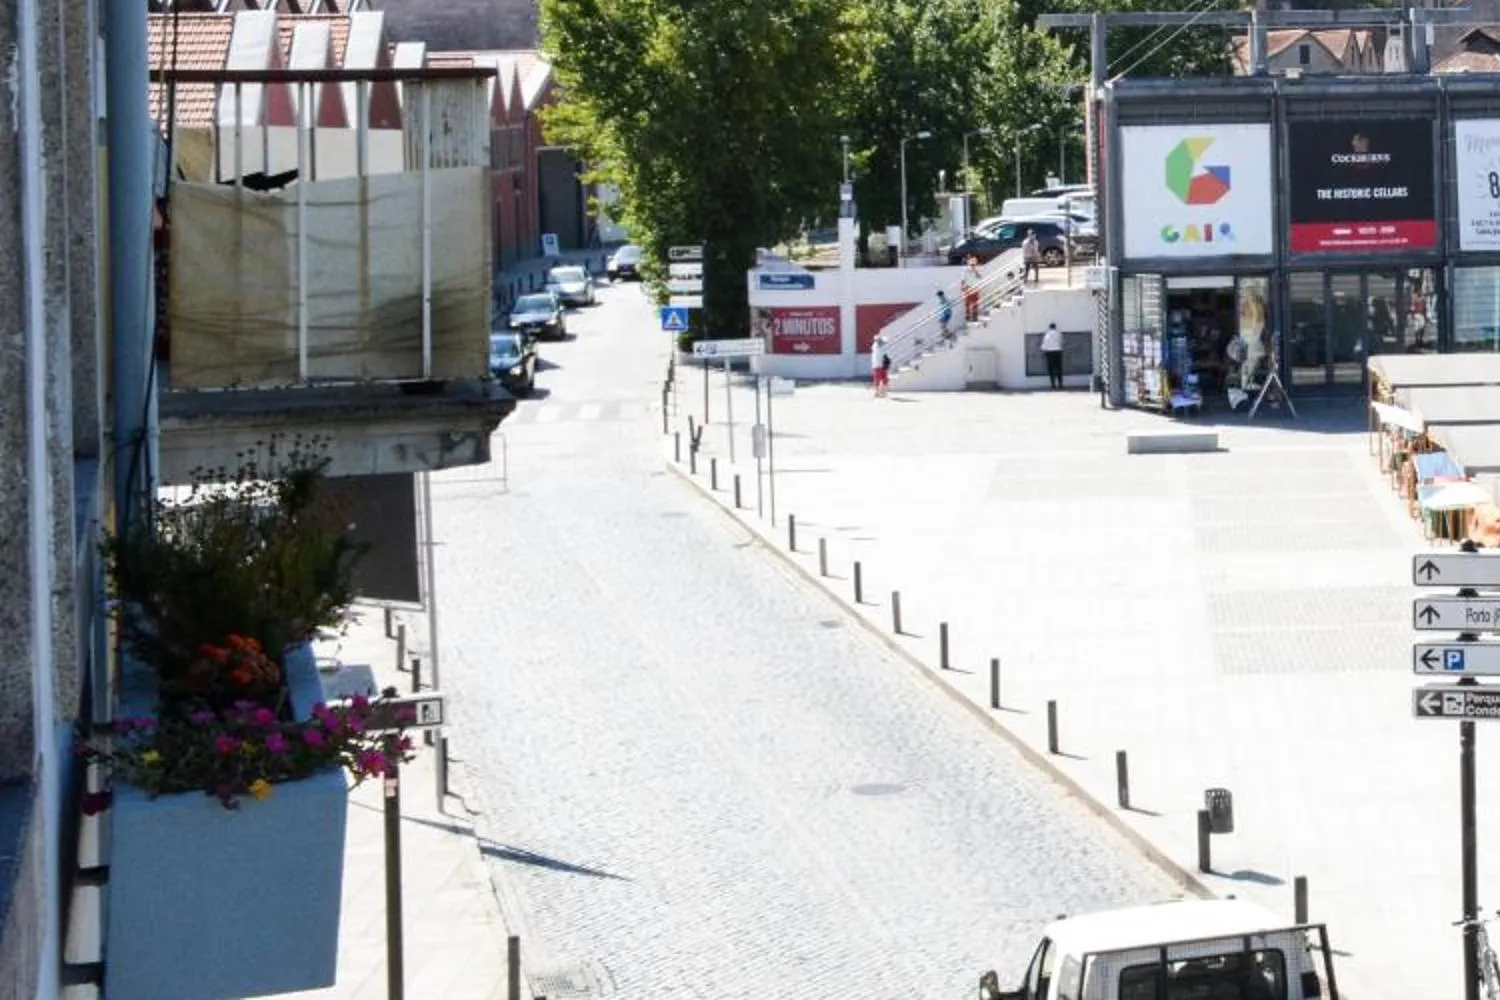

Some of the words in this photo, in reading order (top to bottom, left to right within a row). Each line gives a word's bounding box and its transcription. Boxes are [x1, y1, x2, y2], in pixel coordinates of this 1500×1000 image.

[1373, 186, 1408, 198] CELLARS
[782, 316, 836, 337] MINUTOS
[1465, 607, 1491, 623] Porto
